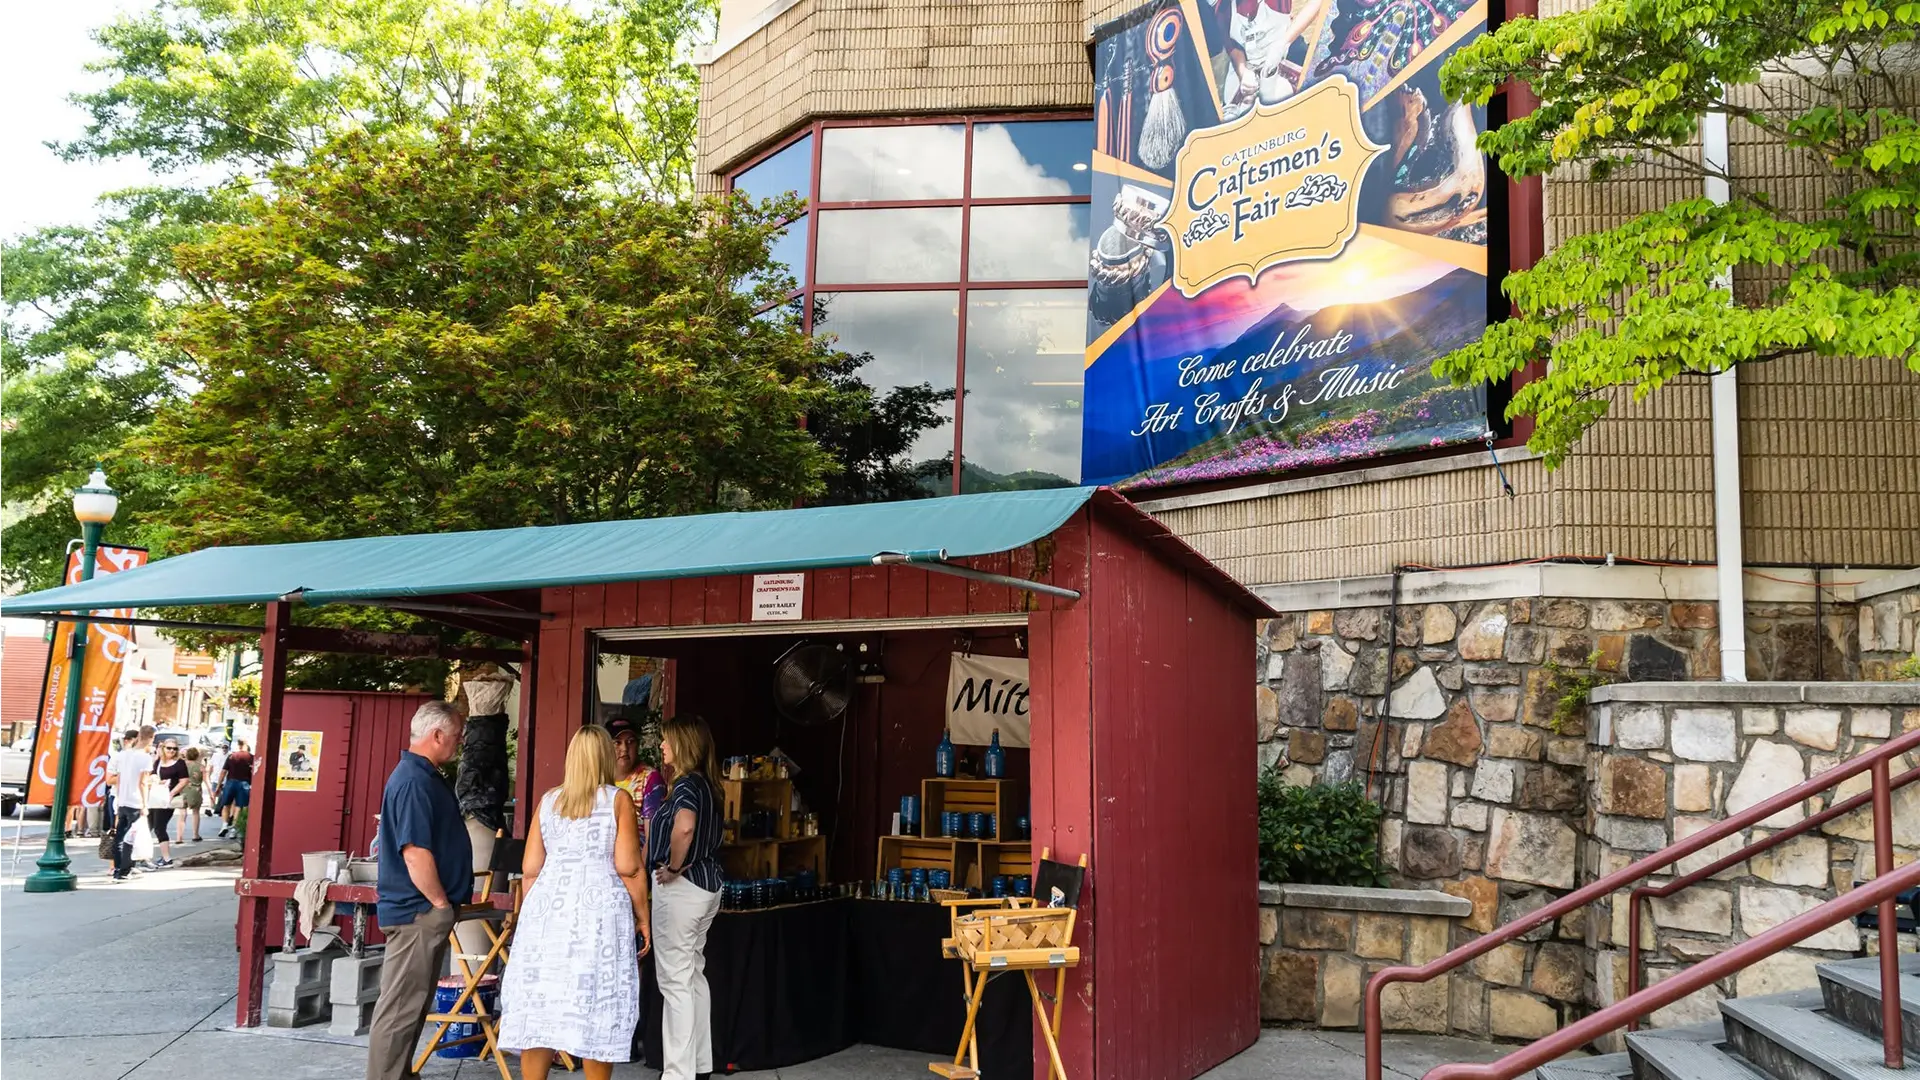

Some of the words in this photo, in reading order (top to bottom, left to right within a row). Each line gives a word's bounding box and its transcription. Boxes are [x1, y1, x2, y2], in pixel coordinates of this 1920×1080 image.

[1187, 131, 1342, 212] Craftsmen's
[1221, 127, 1307, 167] GATLINBURG
[1232, 191, 1280, 241] Fair
[1178, 354, 1237, 387] Come
[1241, 323, 1354, 375] celebrate
[1130, 402, 1184, 436] Art
[1194, 377, 1265, 435] Crafts
[1268, 384, 1296, 424] &
[1299, 363, 1405, 405] Music
[43, 665, 62, 733] GATLINBURG
[78, 686, 110, 734] Fair
